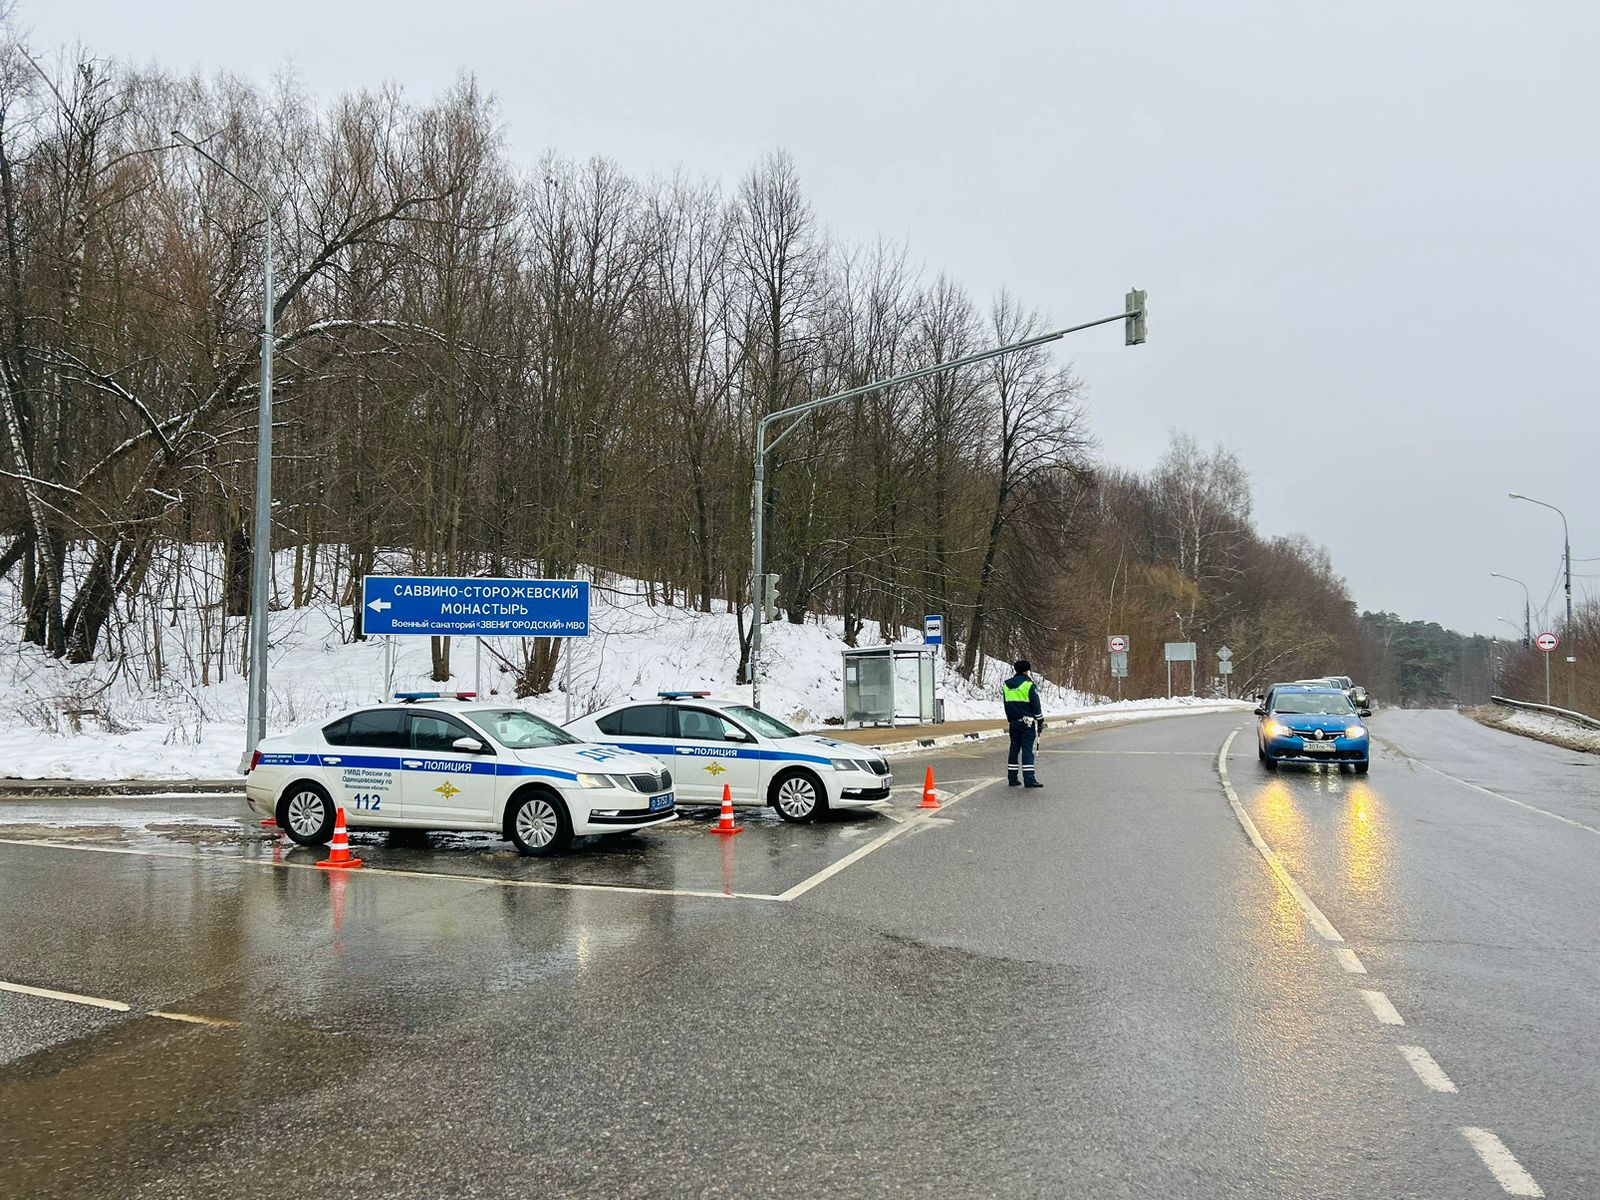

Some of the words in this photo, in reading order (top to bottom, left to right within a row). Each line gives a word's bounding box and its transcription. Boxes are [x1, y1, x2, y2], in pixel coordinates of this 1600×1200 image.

[393, 584, 579, 599] САВВИНО-СТОРОЖЕВСКИЙ
[440, 603, 529, 615] МОНАСТЫРЬ
[391, 619, 429, 628] Военный
[430, 620, 476, 630] санаторий
[476, 619, 565, 630] «ЗВЕНИГОРОДСКИЙ»
[565, 621, 586, 630] МВО
[694, 747, 738, 757] ПОЛИЦИЯ
[424, 760, 472, 772] ПОЛИЦИЯ
[342, 776, 384, 785] Одинцовскому
[354, 793, 381, 810] 112
